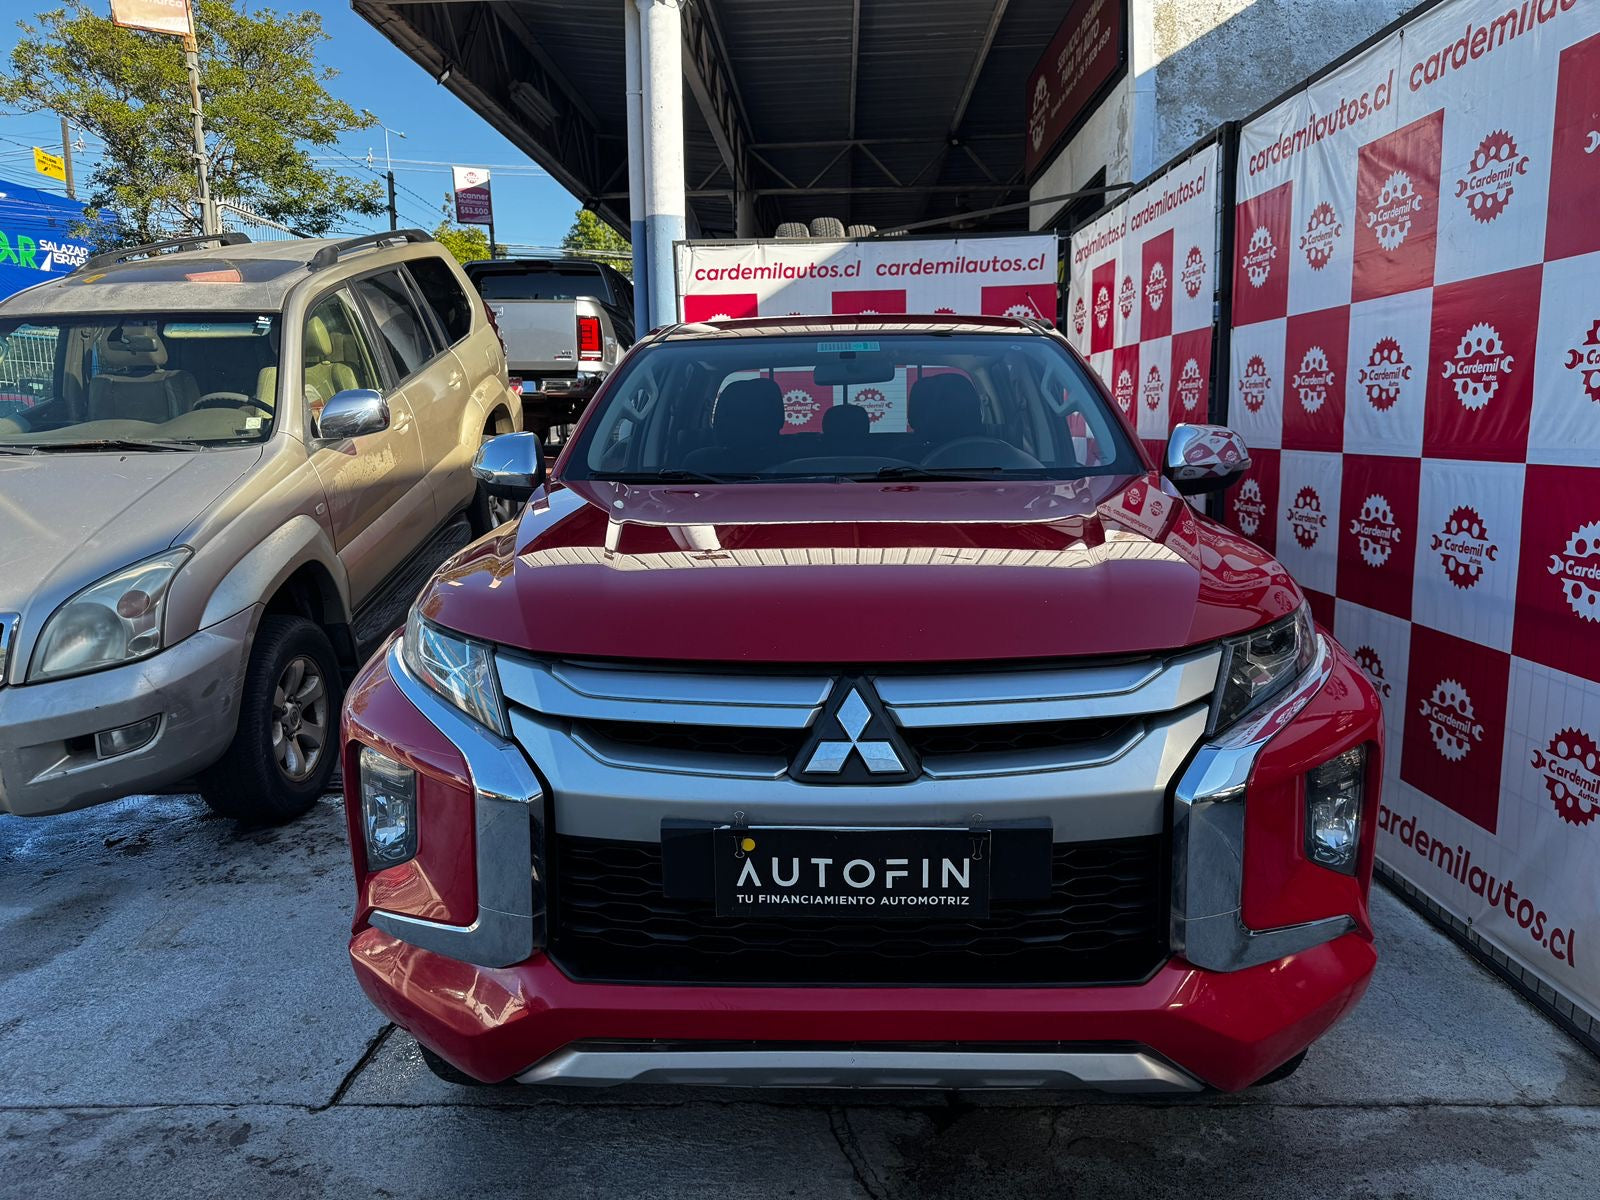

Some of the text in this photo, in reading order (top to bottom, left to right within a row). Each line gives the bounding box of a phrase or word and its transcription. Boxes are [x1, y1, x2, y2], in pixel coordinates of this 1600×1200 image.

[1249, 69, 1394, 176] cardemilautos.cl
[1470, 162, 1515, 190] Cardemil
[1496, 180, 1512, 190] Autos
[457, 192, 489, 201] Scanner
[1131, 166, 1206, 232] cardemilautos.cl
[1378, 202, 1411, 222] Cardemil
[1308, 227, 1333, 245] Cardemil
[1250, 249, 1271, 264] Cardemil
[694, 253, 1045, 281] cardemilautos.cl cardemilautos.cl
[1369, 366, 1401, 381] Cardemil
[1457, 357, 1500, 374] Cardemil
[1244, 378, 1265, 389] Cardemil
[1301, 374, 1326, 385] Cardemil
[1482, 373, 1497, 381] Autos
[1294, 512, 1319, 524] Cardemil
[1360, 524, 1392, 539] Cardemil
[1444, 538, 1484, 557] Cardemil
[1565, 559, 1600, 580] Carde
[1432, 706, 1471, 734] Cardemil
[1548, 759, 1600, 795] Cardemil
[1578, 789, 1598, 804] Autos
[736, 857, 970, 889] AUTOFIN
[1378, 803, 1576, 969] ardemilautos.cl
[737, 894, 970, 906] TU FINANCIAMIENTO AUTOMOTRIZ
